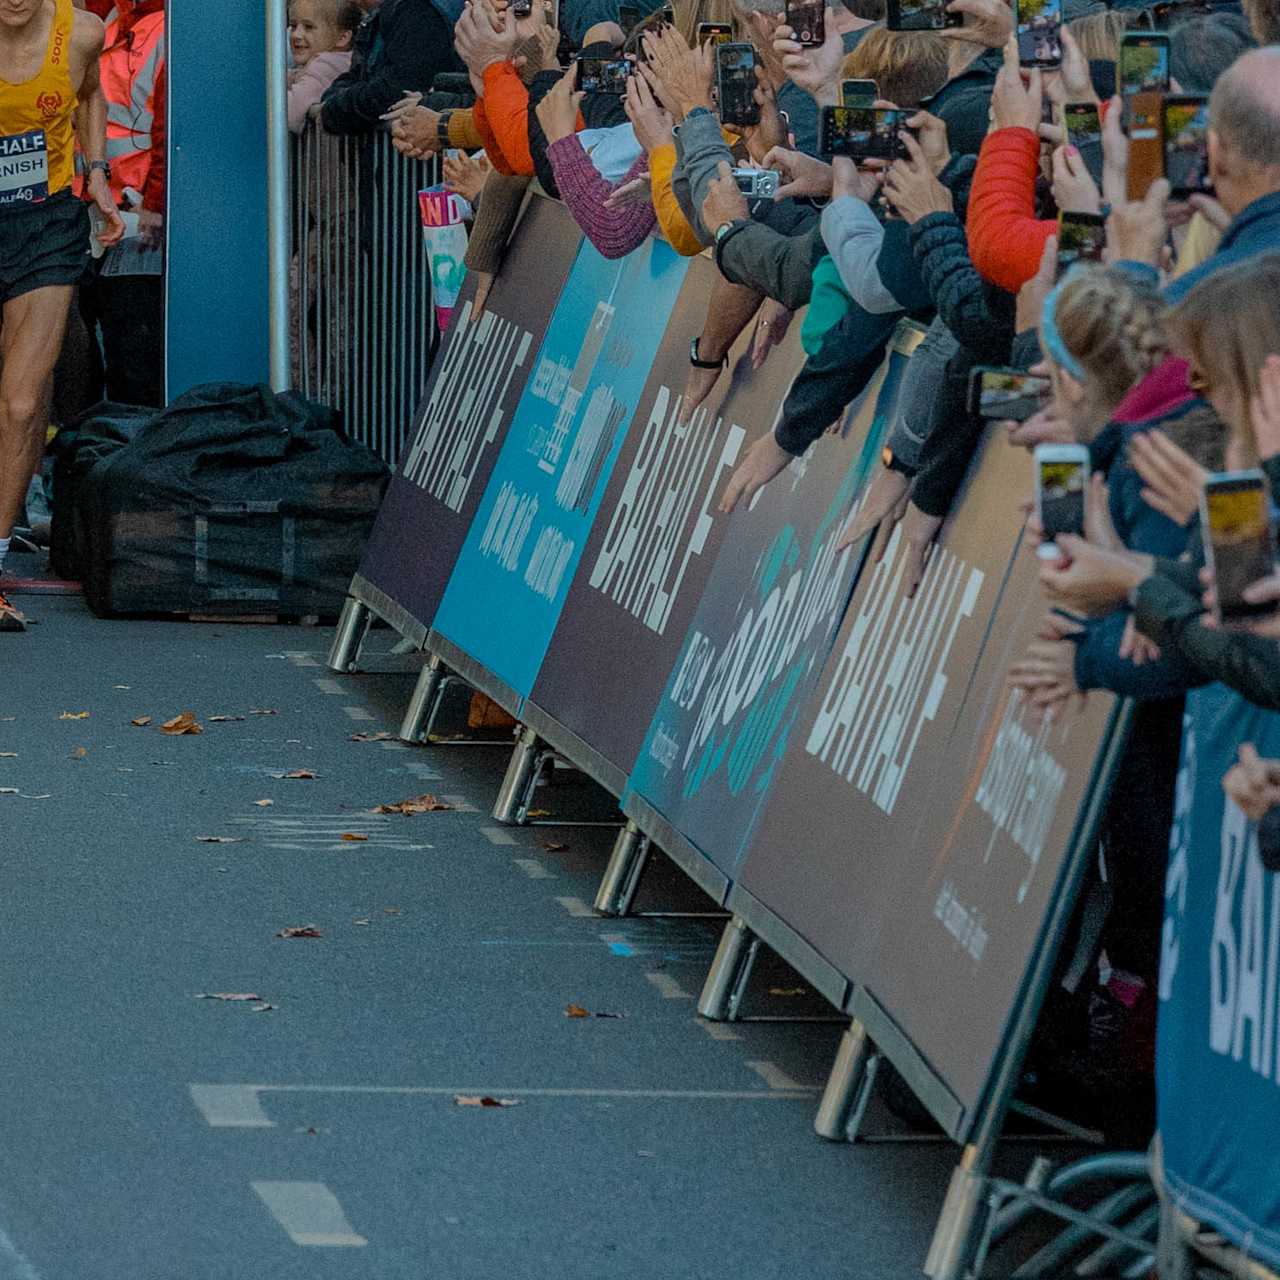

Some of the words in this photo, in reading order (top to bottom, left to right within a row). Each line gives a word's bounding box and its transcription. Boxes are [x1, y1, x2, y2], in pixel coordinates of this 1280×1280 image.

[403, 300, 534, 513] BATHALF
[589, 385, 746, 635] BATHALF
[805, 521, 985, 816] BATHALF
